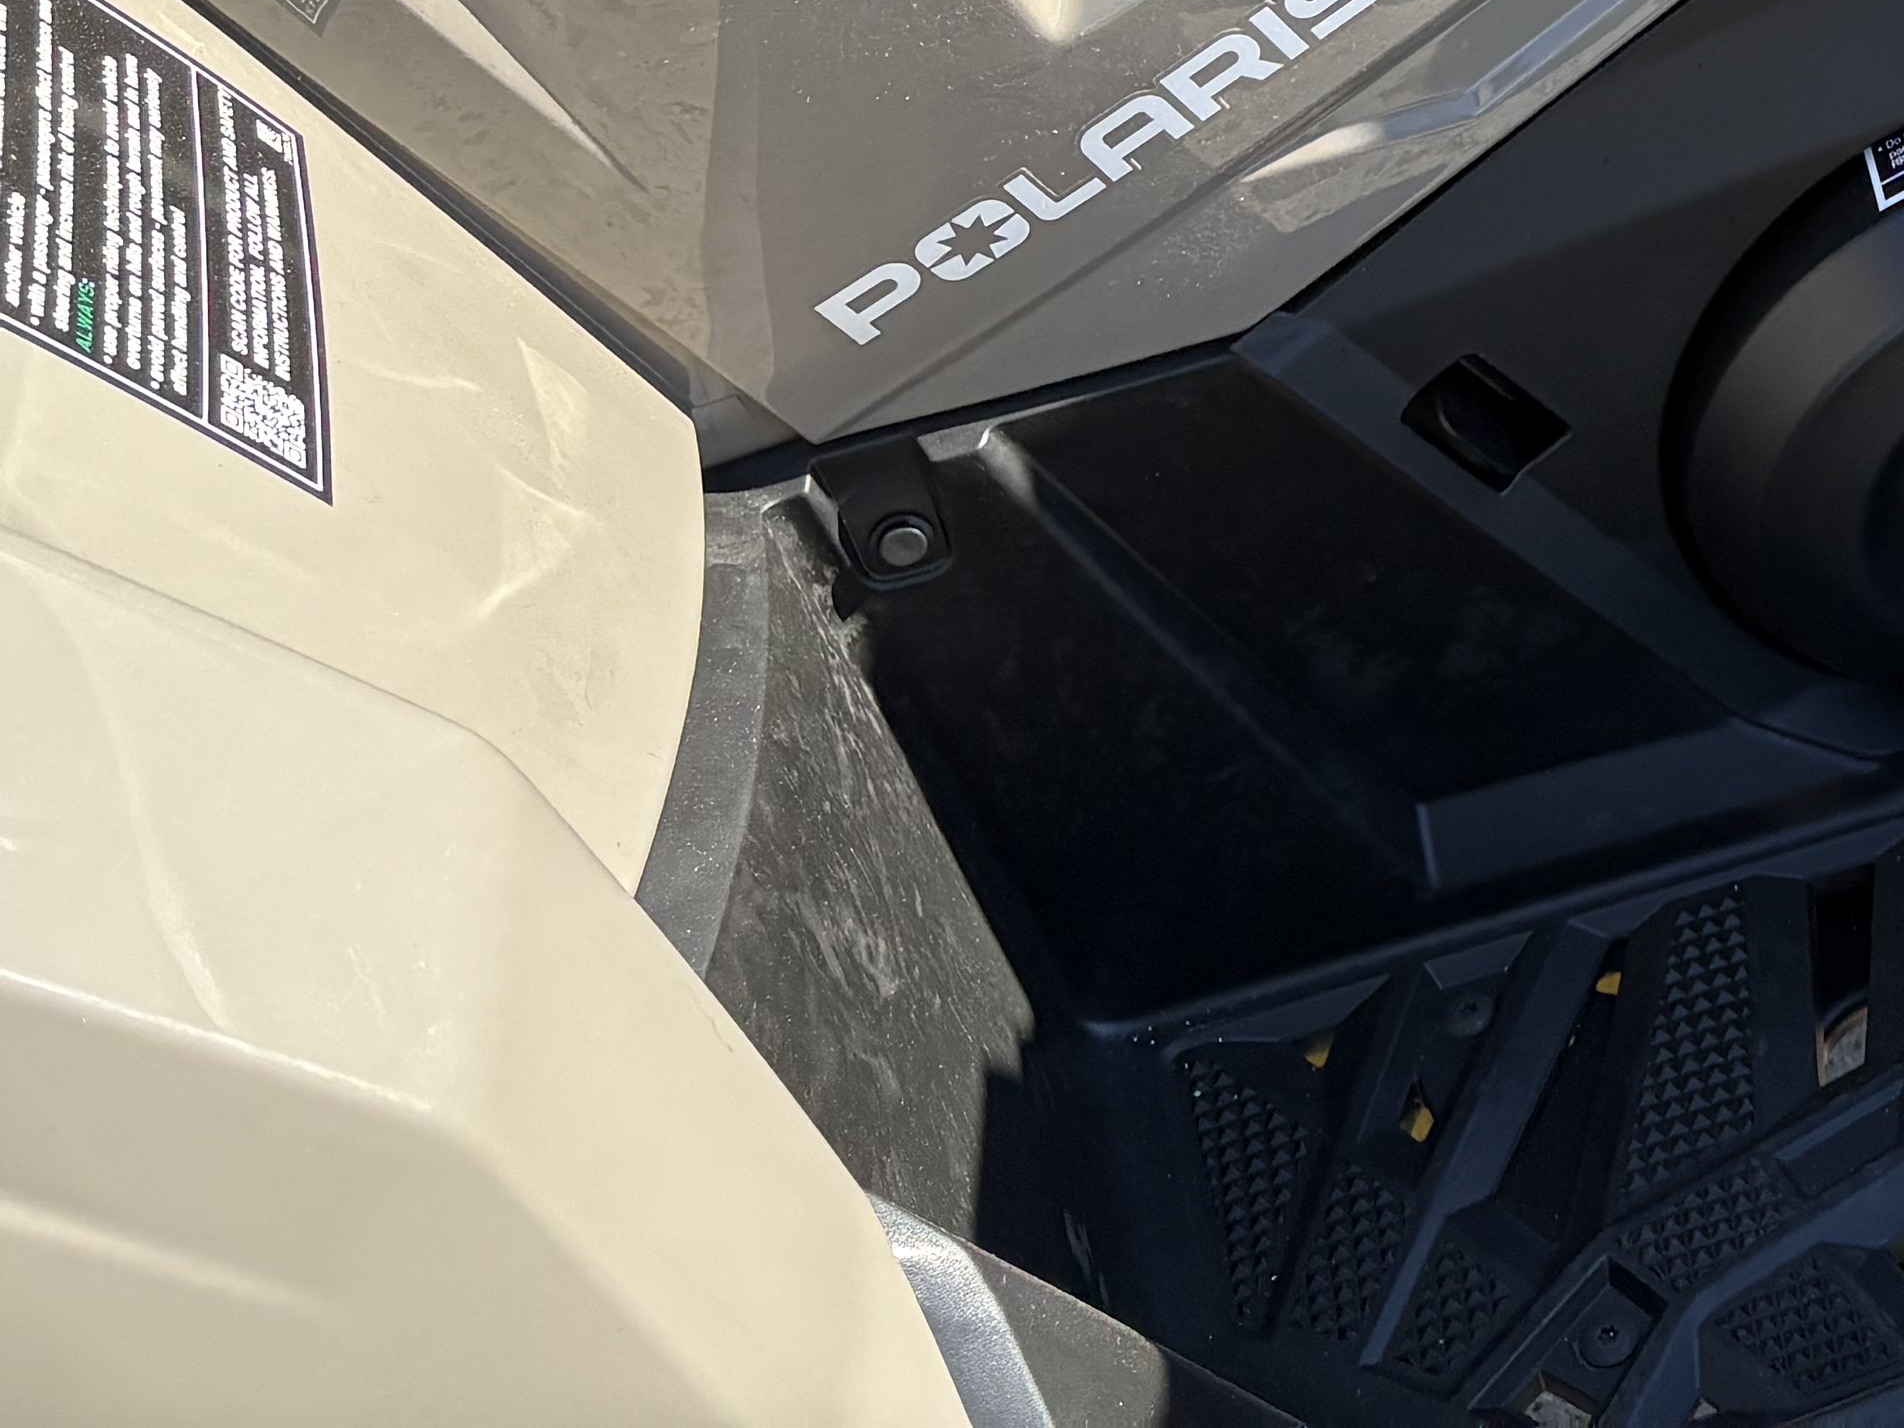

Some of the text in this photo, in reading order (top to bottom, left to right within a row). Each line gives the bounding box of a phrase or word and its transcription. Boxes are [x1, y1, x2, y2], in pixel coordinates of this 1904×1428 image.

[35, 21, 53, 73] balance
[35, 69, 53, 111] affect
[36, 109, 56, 191] passengers
[52, 46, 79, 332] steering and increase risk of losing control
[6, 192, 26, 245] vehicle
[33, 194, 54, 274] passenger
[101, 55, 124, 356] use proper riding techniques to avoid vehicle
[123, 53, 146, 370] overturns on hills and rough terrain and in turns
[143, 68, 168, 382] avoid paved surfaces pavement may seriously
[217, 86, 249, 356] SCAN CODE FOR PRODUCT AND SAFETY
[4, 244, 23, 307] another
[32, 270, 47, 285] a
[243, 173, 269, 369] INFORMATION. FOLLOW ALL
[267, 240, 285, 275] AND
[27, 283, 46, 317] with
[74, 277, 97, 354] ALWAYS:
[169, 205, 191, 396] affect handling and control
[269, 272, 291, 381] INSTRUCTIONS
